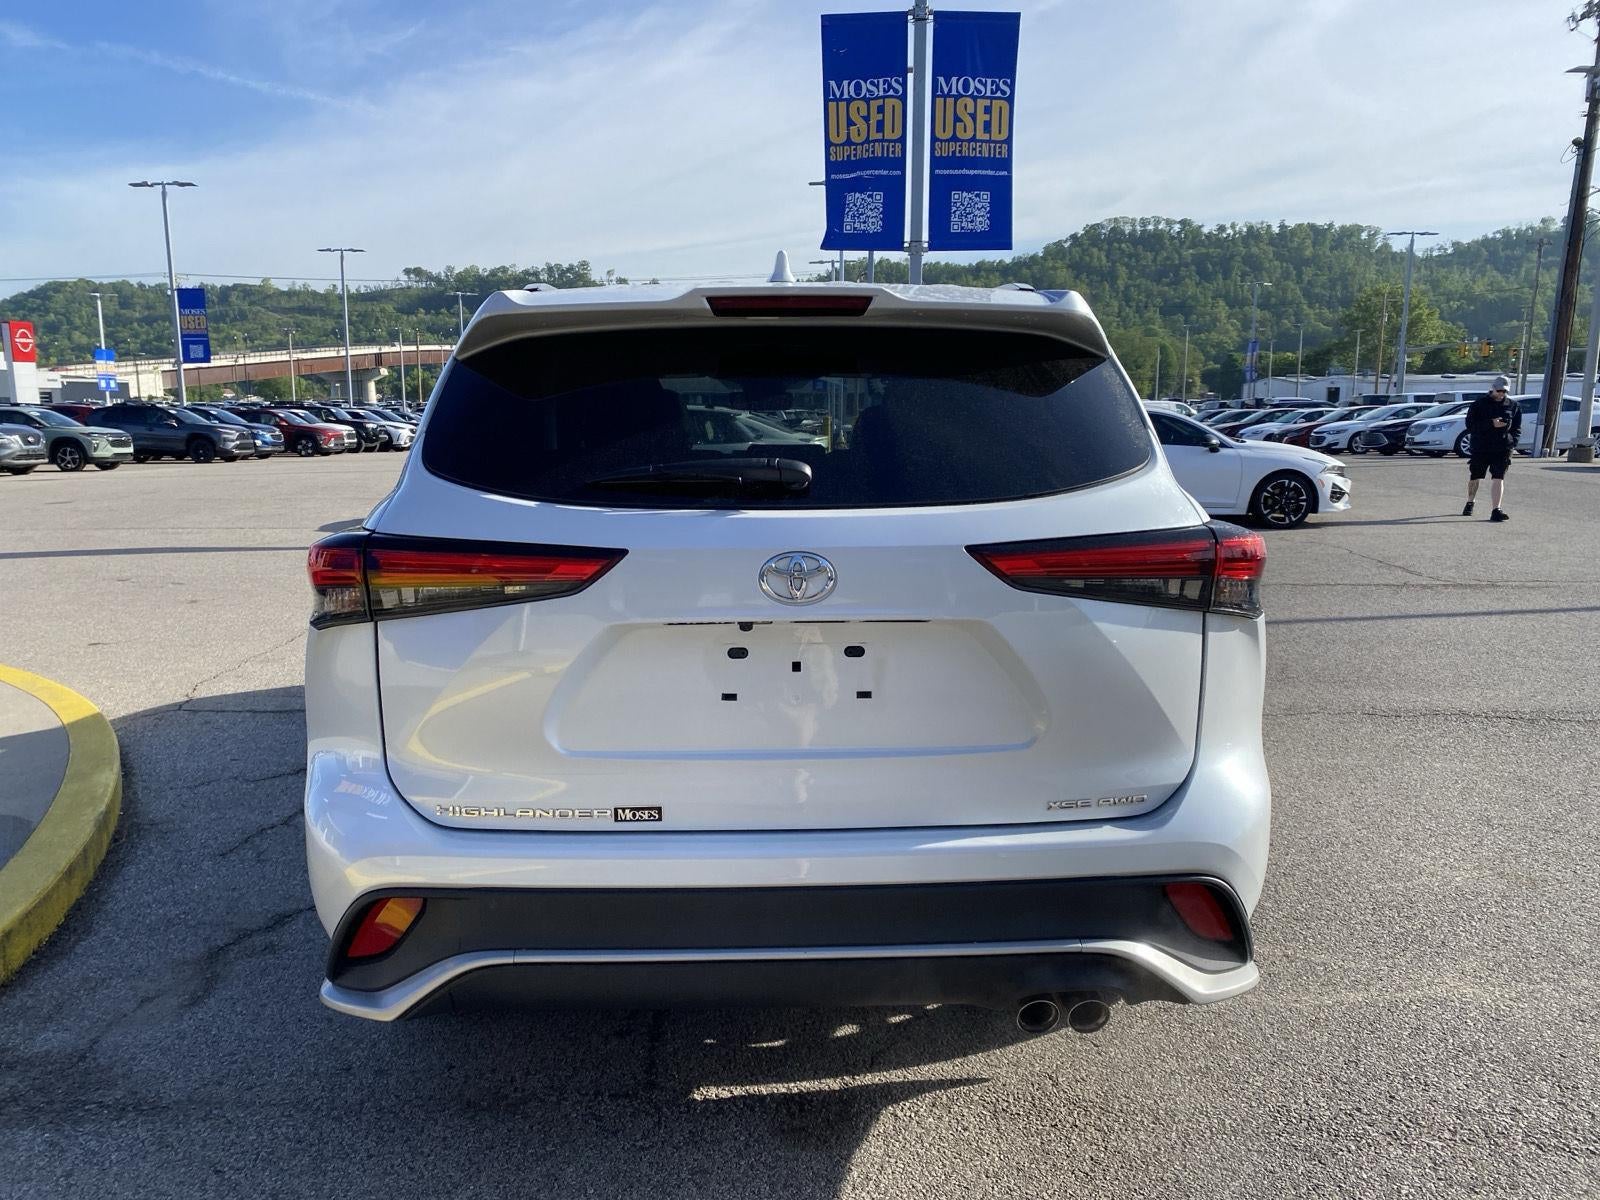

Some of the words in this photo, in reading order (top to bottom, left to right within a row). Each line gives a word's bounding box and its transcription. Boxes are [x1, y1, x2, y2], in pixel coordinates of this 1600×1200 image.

[828, 77, 903, 99] MOSES
[936, 76, 1011, 97] MOSES
[828, 98, 903, 144] USED
[934, 97, 1009, 141] USED
[829, 142, 902, 161] SUPERCENTER
[934, 141, 1008, 158] SUPERCENTER
[181, 315, 207, 329] USED
[1046, 799, 1092, 811] XSE
[1098, 794, 1148, 808] AWD
[436, 805, 613, 820] HIGHLANDER
